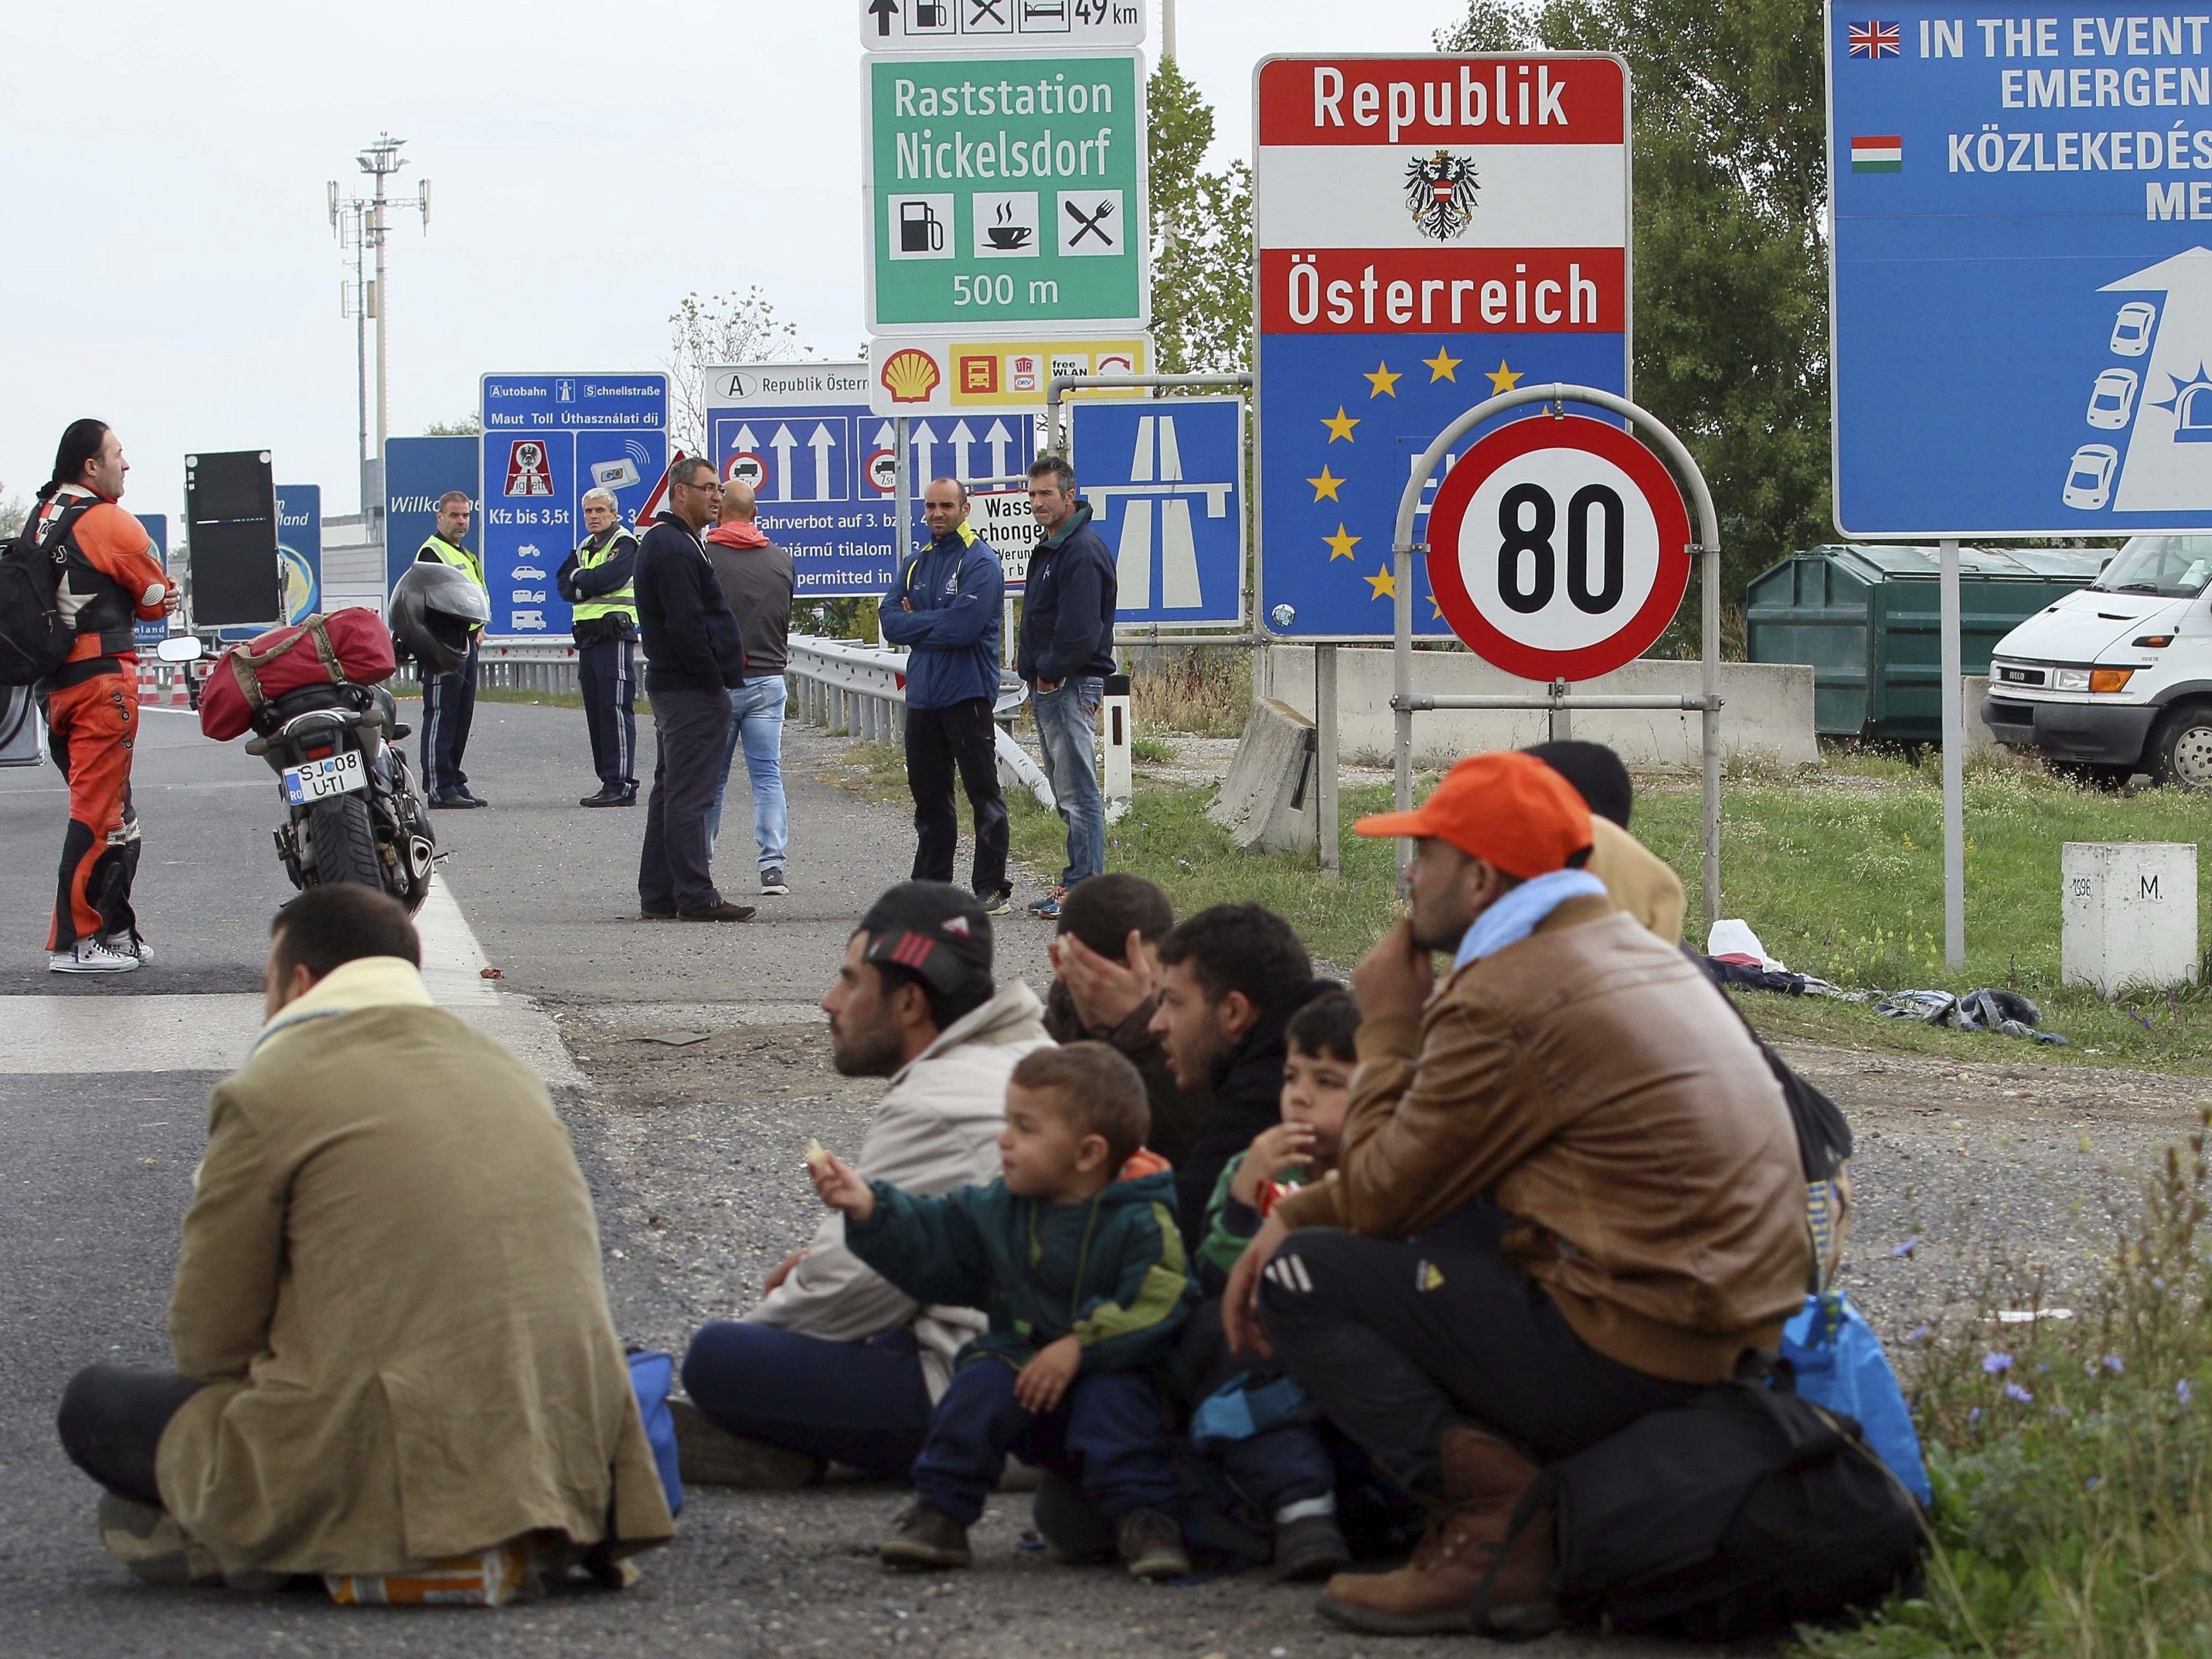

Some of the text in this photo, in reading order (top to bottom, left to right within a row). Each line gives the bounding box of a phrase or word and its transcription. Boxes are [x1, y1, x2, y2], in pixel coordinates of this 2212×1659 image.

[1075, 0, 1137, 25] 49 km
[1920, 17, 2209, 58] IN THE EVENT
[896, 74, 1111, 117] Raststation
[2002, 67, 2212, 108] EMERGEN
[1314, 65, 1569, 142] Republik
[897, 128, 1111, 179] Nickelsdorf
[1948, 119, 2212, 172] KÖZLEKEDÉS
[2146, 182, 2212, 221] ME
[954, 275, 1059, 306] 500 m
[1289, 254, 1597, 324] Österreich
[1015, 357, 1033, 373] UTA
[1053, 368, 1088, 377] WLAN
[491, 386, 547, 397] Autobahn
[586, 385, 660, 397] Schnellstraße
[728, 375, 744, 396] A
[763, 374, 869, 394] Republik Österr
[491, 410, 658, 426] Maut Toll Úthasználati díj
[881, 475, 893, 485] 7,5t
[489, 509, 569, 525] Kfz bis 3,5t
[985, 498, 1032, 518] Wass
[279, 512, 309, 525] land
[838, 514, 863, 527] auf
[866, 515, 878, 527] 3.
[883, 513, 915, 527] bz.
[970, 522, 1042, 544] chonge
[838, 542, 892, 556] tilalom
[998, 548, 1033, 562] Verun
[1498, 482, 1625, 614] 80
[798, 569, 892, 588] permitted in
[134, 625, 164, 633] nland
[2009, 671, 2025, 681] IVECO
[300, 754, 357, 781] SJ 08
[291, 789, 302, 800] RO
